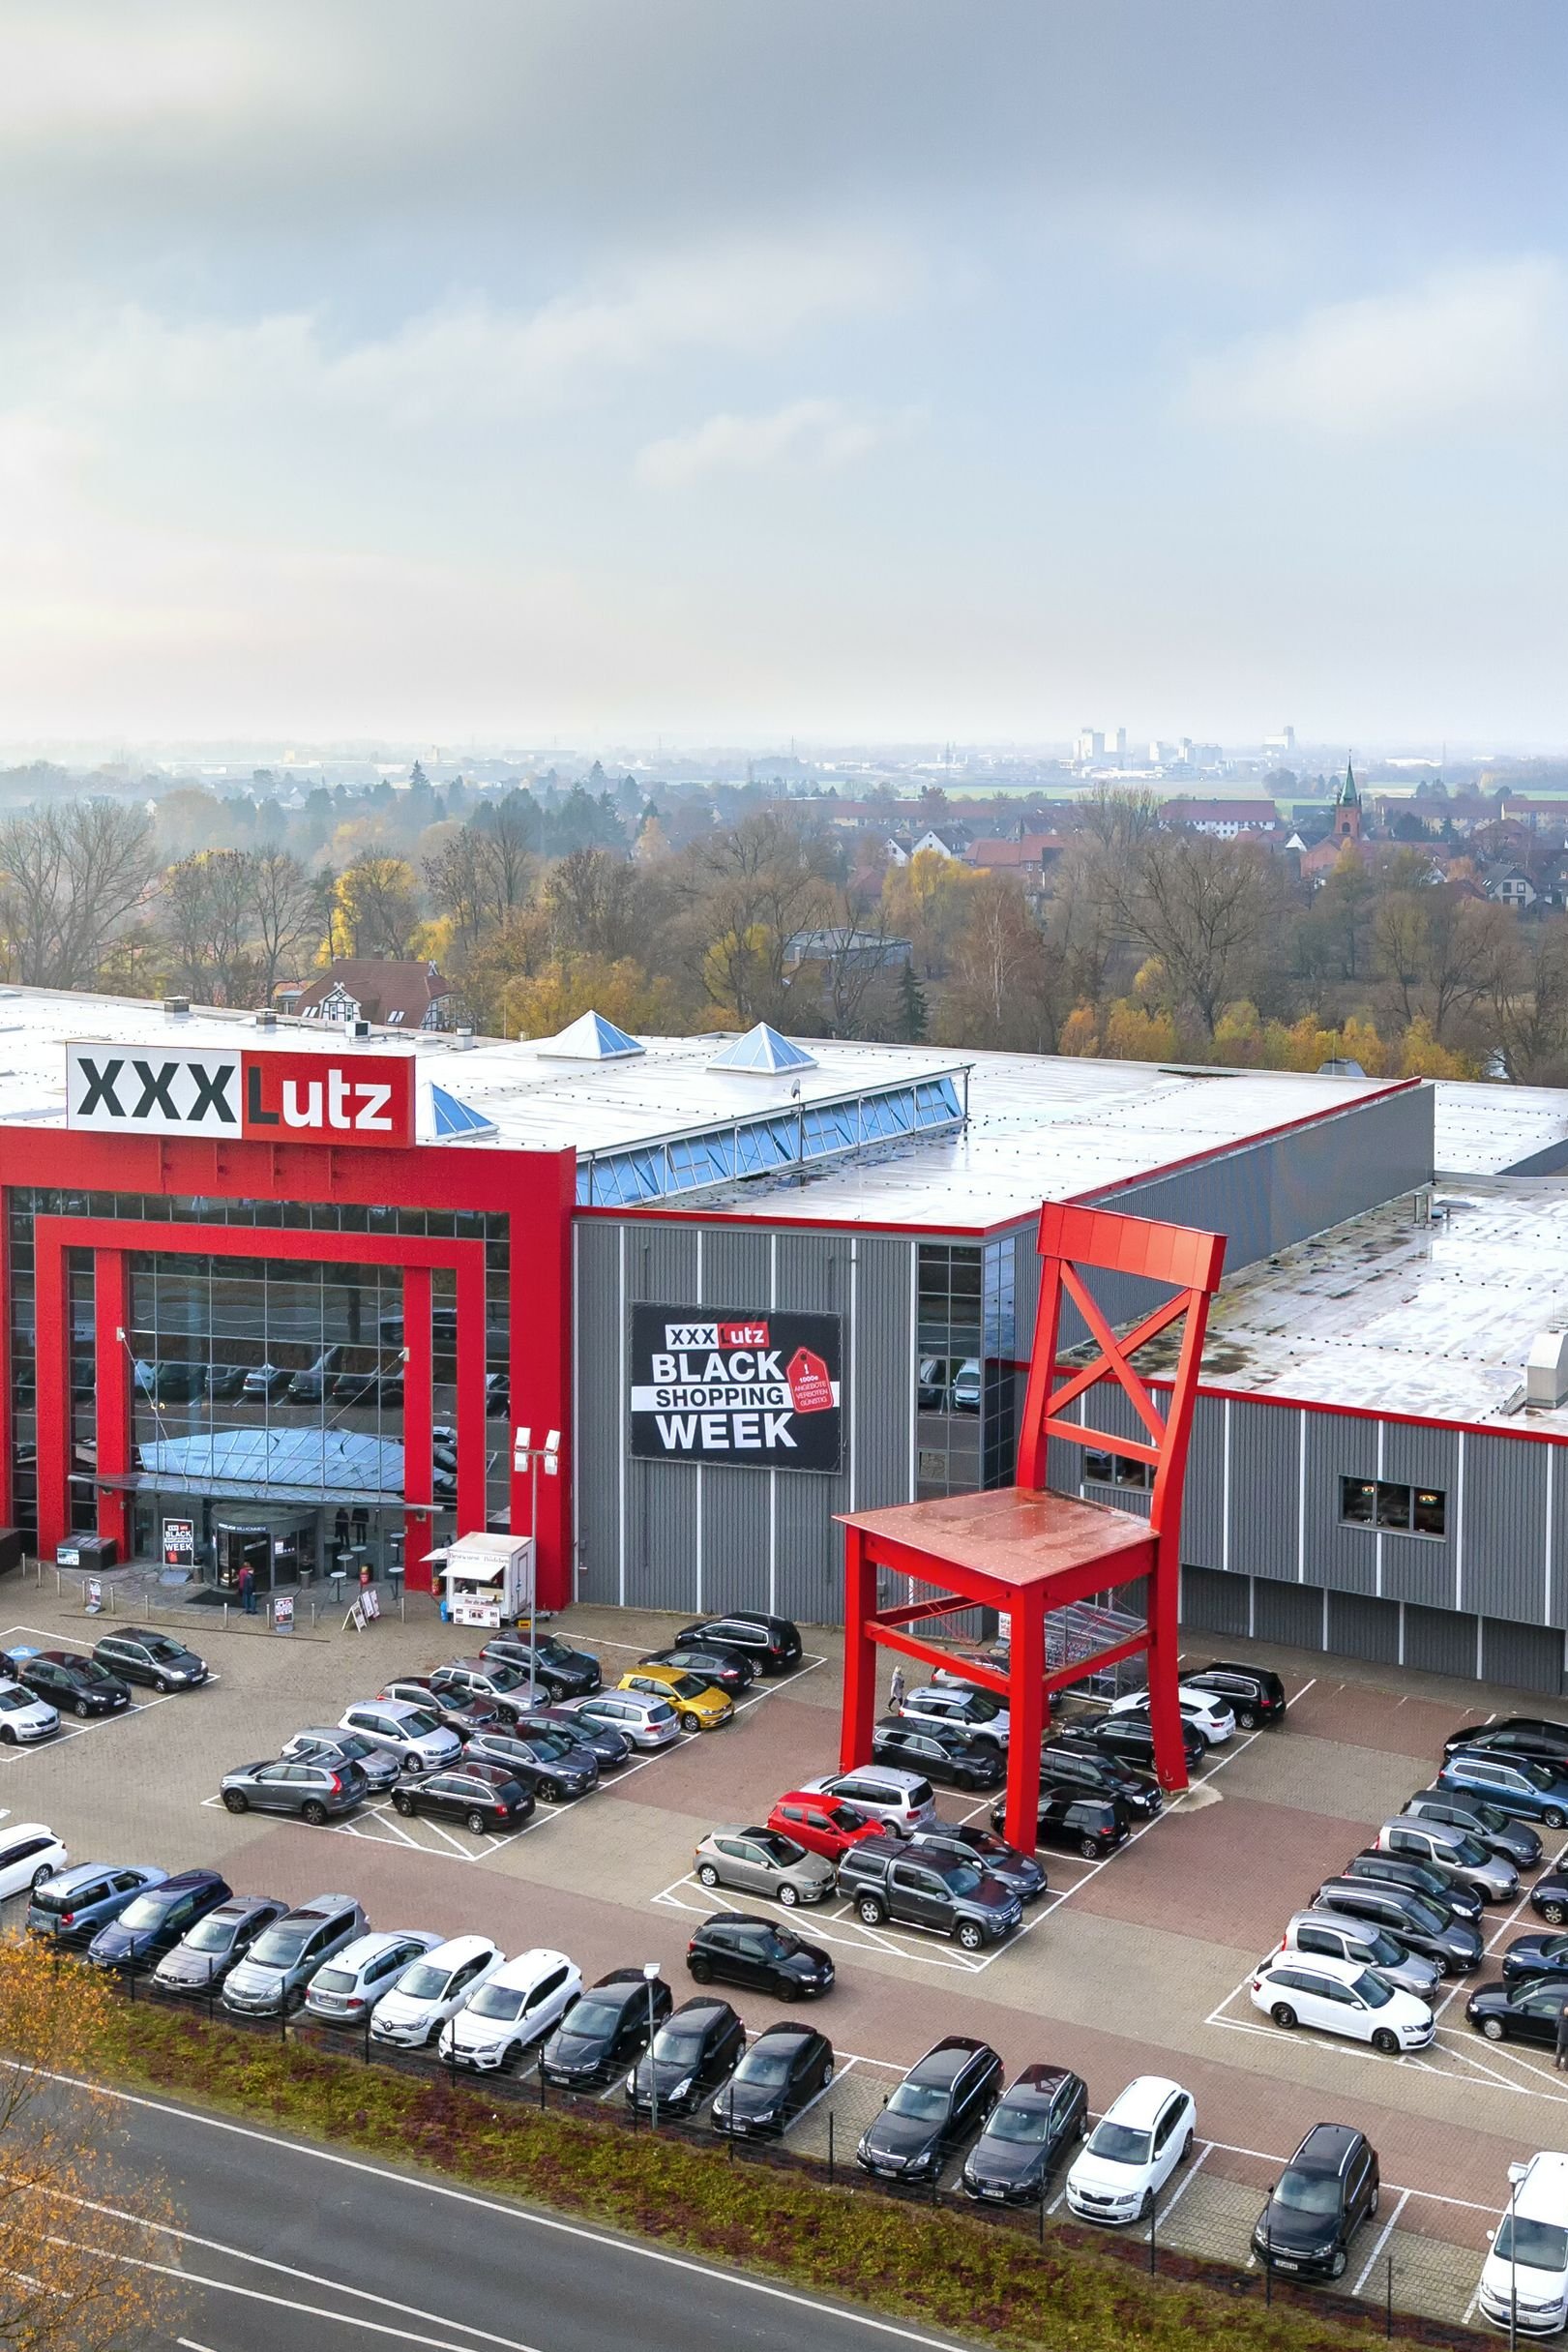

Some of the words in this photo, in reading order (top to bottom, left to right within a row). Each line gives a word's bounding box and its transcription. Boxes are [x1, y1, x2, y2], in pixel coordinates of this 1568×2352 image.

[652, 1351, 785, 1384] BLACK
[656, 1386, 784, 1408] SHOPPING
[655, 1413, 798, 1449] WEEK
